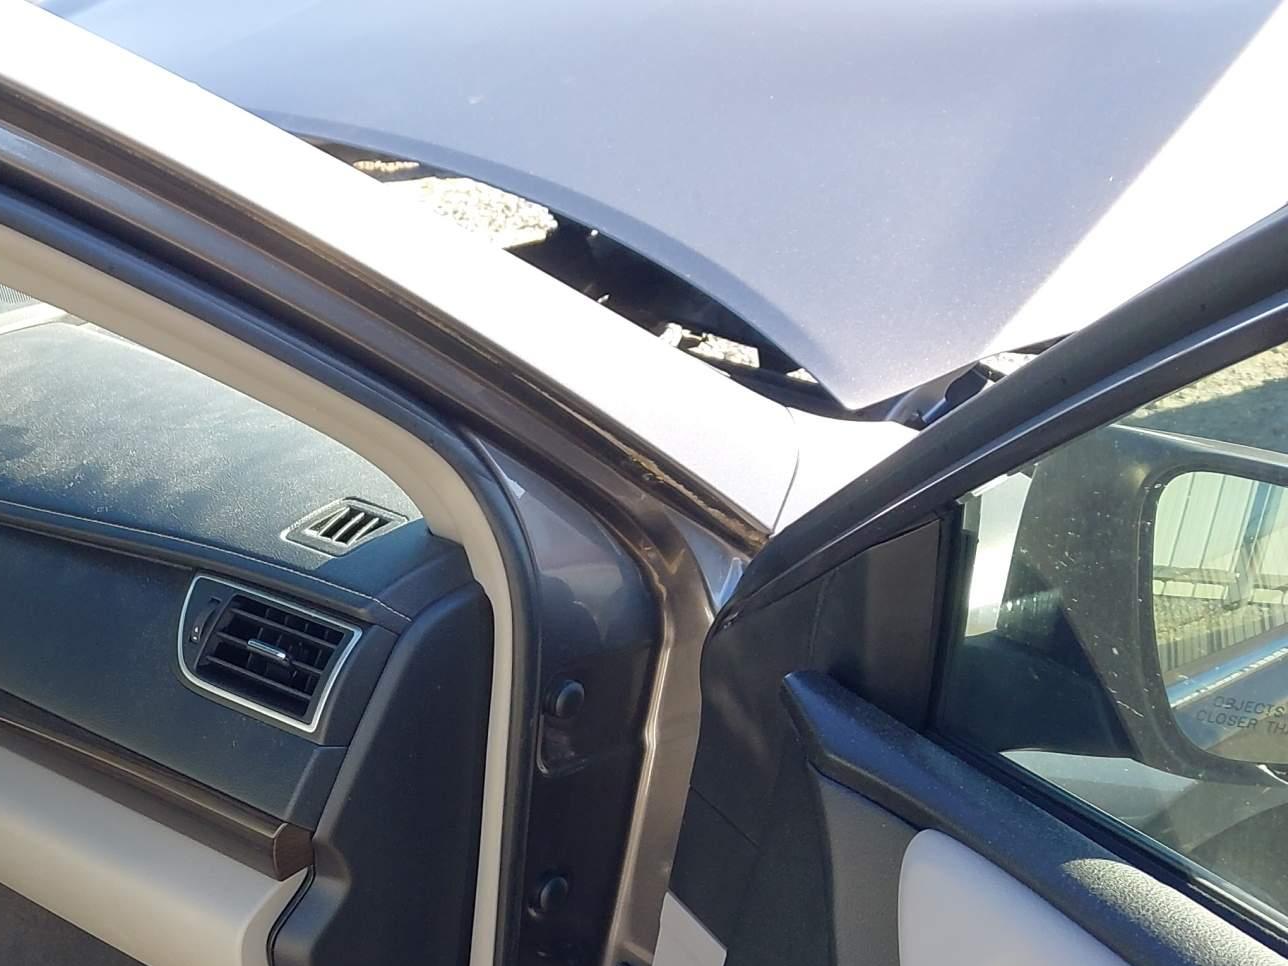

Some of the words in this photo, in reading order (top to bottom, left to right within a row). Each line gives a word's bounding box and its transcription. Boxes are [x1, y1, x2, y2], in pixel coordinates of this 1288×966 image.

[1214, 696, 1285, 717] OBJECTS
[1196, 710, 1258, 728] CLOSER
[1267, 720, 1288, 735] TH
